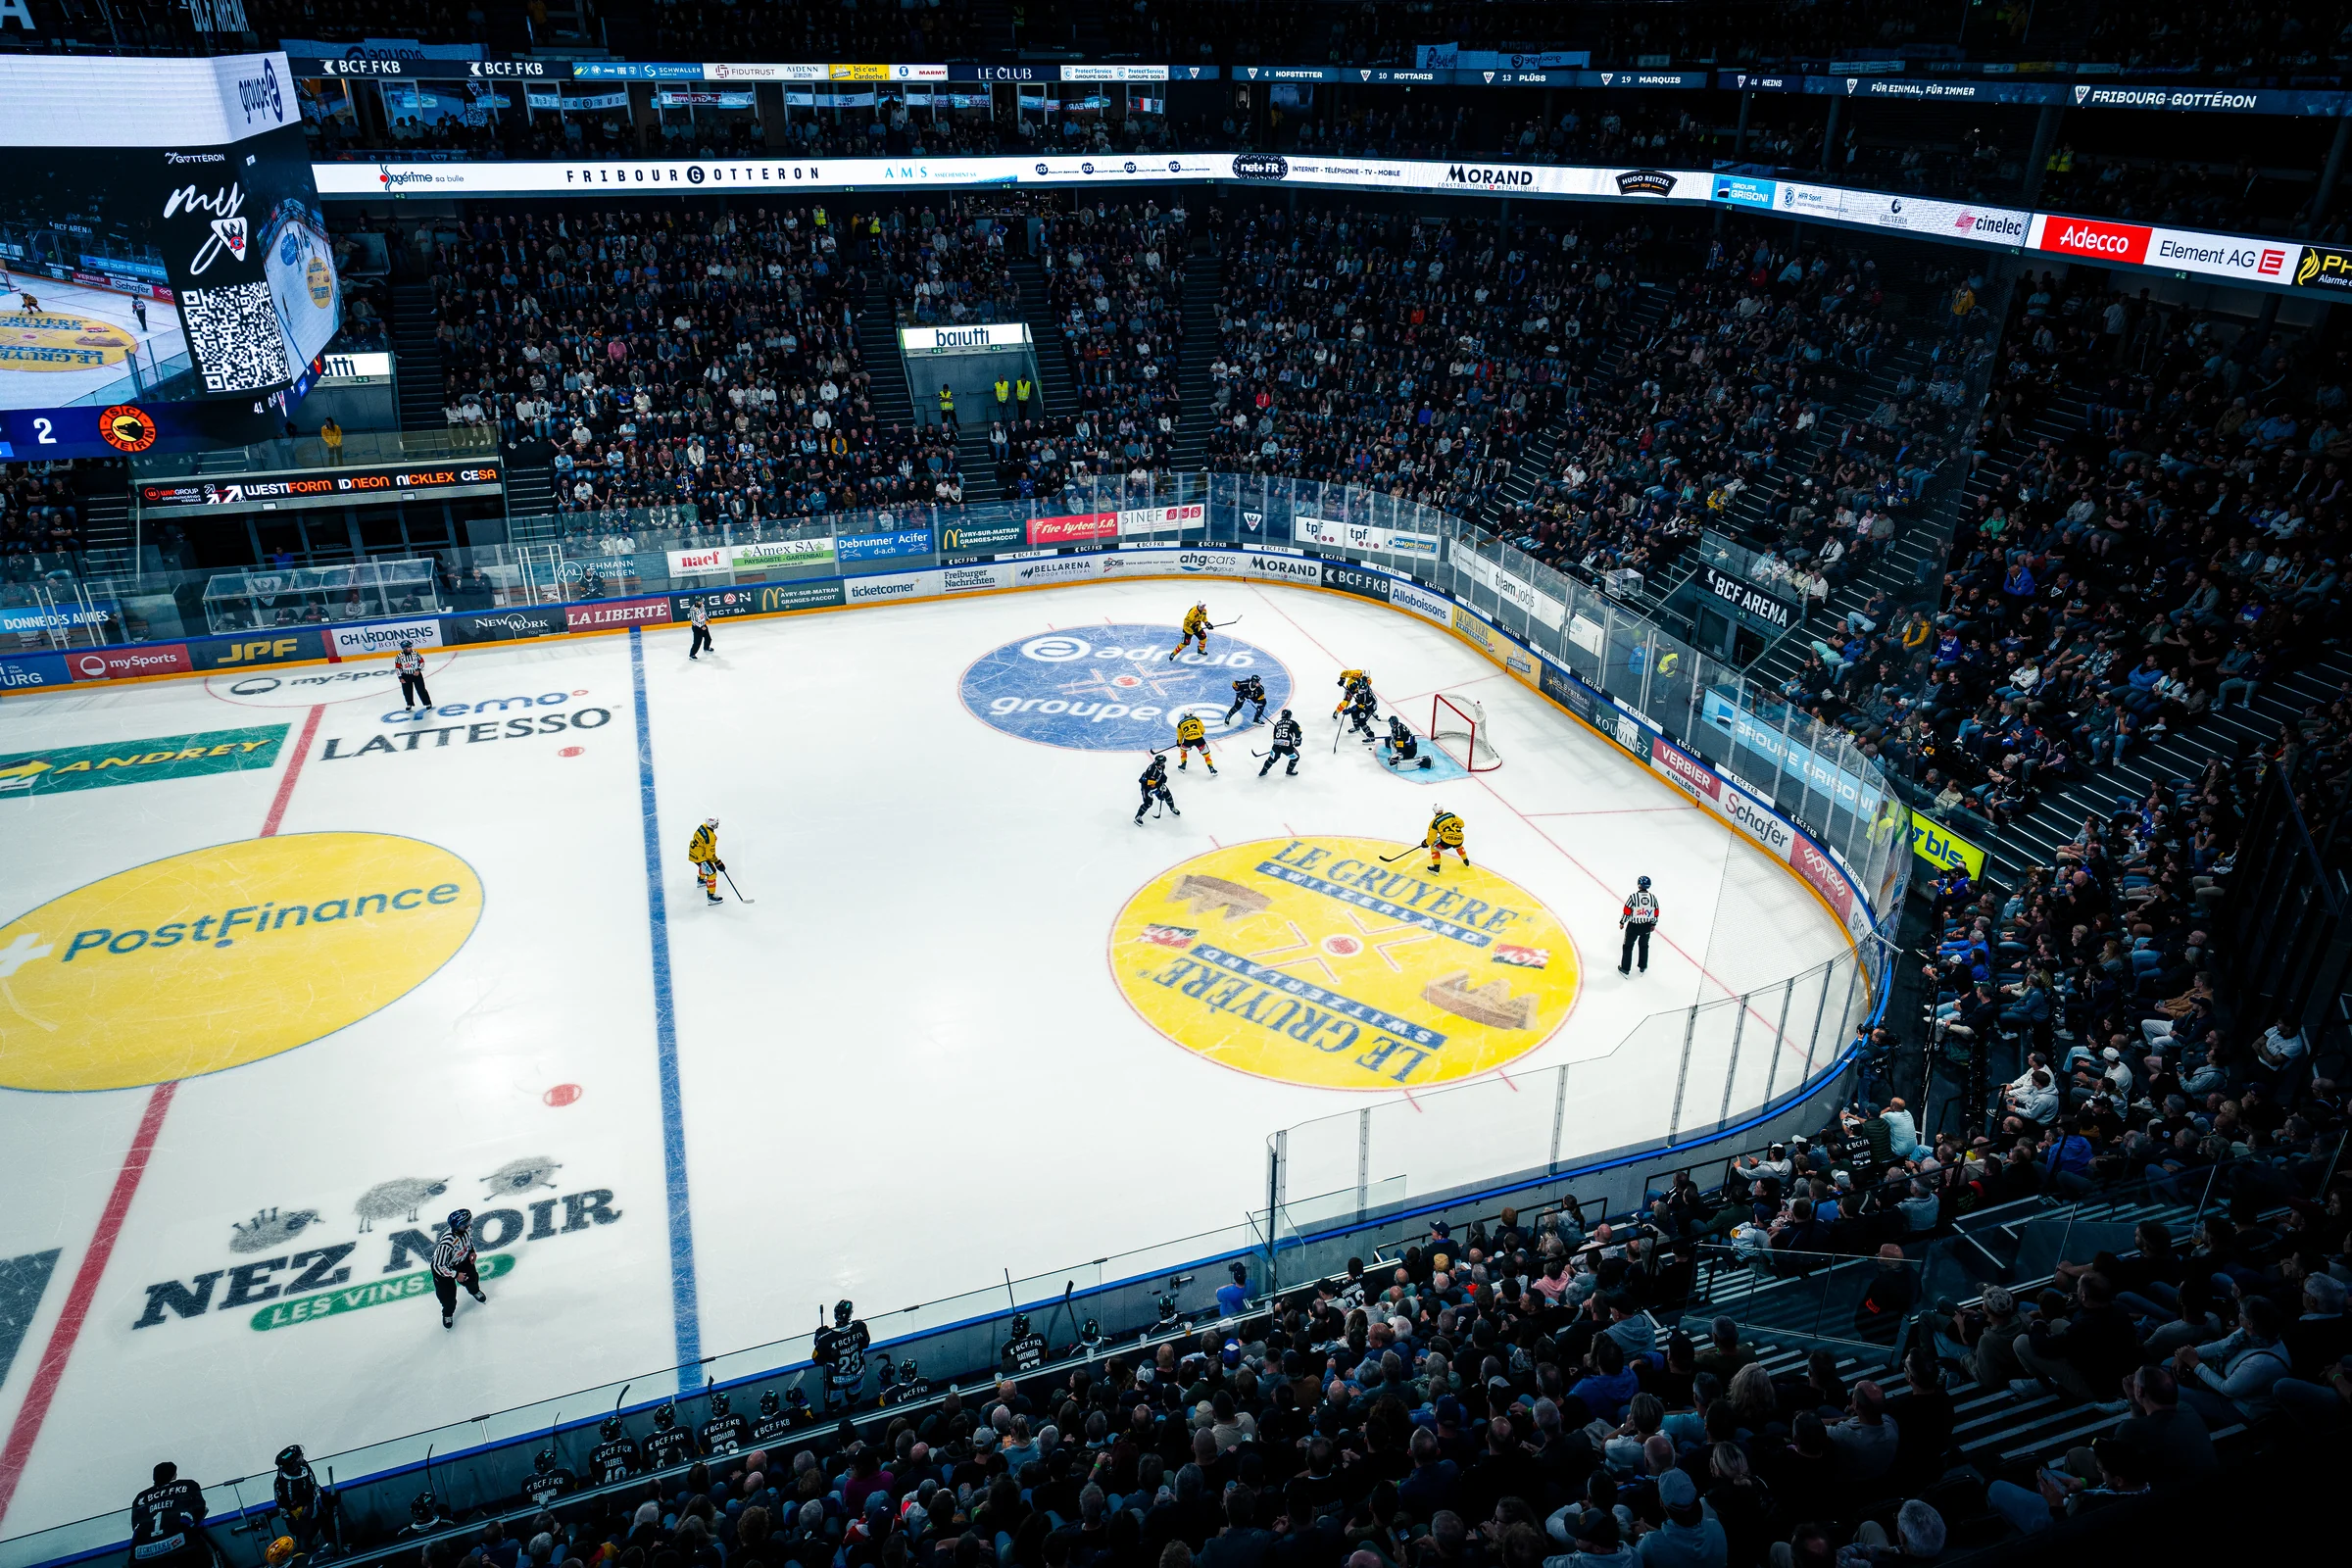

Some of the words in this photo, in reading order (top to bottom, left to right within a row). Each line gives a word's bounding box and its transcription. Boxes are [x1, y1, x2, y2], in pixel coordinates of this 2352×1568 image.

[977, 68, 994, 80] LE
[997, 67, 1033, 80] CLUB
[1378, 72, 1388, 80] 10
[1394, 73, 1434, 81] ROTTARIS
[1502, 74, 1512, 82] 13
[1518, 73, 1546, 82] PLÜSS
[1621, 75, 1632, 84] 19
[1638, 75, 1682, 85] MARQUIS
[1871, 82, 1887, 93] FÜR
[1925, 84, 1943, 95] FÜR
[1943, 86, 1976, 97] IMMER
[239, 77, 270, 124] groupe
[2090, 89, 2257, 109] FRIBOURG-GOTTÉRON
[1265, 162, 1280, 173] FR
[1292, 165, 1320, 173] INTERNET
[1446, 164, 1534, 185] MORAND
[447, 172, 465, 182] bulle
[1621, 174, 1644, 185] HUGO
[1644, 174, 1671, 187] REITZEL
[1732, 182, 1757, 192] GROUPE
[1730, 190, 1769, 203] GRISONI
[69, 224, 93, 234] ARENA
[1976, 215, 2022, 236] cinelec
[2059, 224, 2130, 254] Adecco
[2159, 239, 2225, 265] Element
[2226, 251, 2257, 269] AG
[77, 273, 106, 283] VERBIER
[2318, 274, 2347, 286] Alarme
[115, 279, 151, 295] Schafer
[32, 417, 58, 445] 2
[337, 476, 390, 490] IDNEON
[395, 471, 456, 487] NICKLEX
[460, 468, 498, 482] CESA
[244, 480, 333, 496] WESTIFORM
[959, 527, 1020, 538] AVRY-SUR-MATRAN
[959, 535, 1018, 545] GRANGES-PACCOT
[1350, 527, 1368, 542] tpf
[753, 542, 791, 558] Amex
[795, 540, 816, 554] SA
[838, 537, 894, 551] Debrunner
[898, 532, 928, 545] Acifer
[681, 551, 720, 568] naef
[744, 556, 783, 565] PAYSAGISTE
[786, 552, 824, 563] GARTENBAU
[1034, 561, 1091, 573] BELLARENA
[1179, 553, 1237, 566] ahgcars
[1249, 555, 1317, 577] MORAND
[944, 568, 988, 581] Freiburger
[944, 576, 996, 588] Nachrichten
[780, 587, 840, 598] AVRY-SUR-MATRAN
[851, 582, 915, 598] ticketcorner
[780, 595, 836, 605] GRANGES-PACCOT
[1392, 587, 1447, 620] Alloboissons
[1713, 575, 1743, 604] BCF
[1740, 590, 1788, 628] ARENA
[4, 615, 48, 630] DONNE
[567, 613, 592, 626] LA
[594, 602, 668, 624] LIBERTÉ
[340, 626, 434, 650] CHARDONNENS
[218, 637, 298, 667] JPF
[109, 653, 178, 672] mySports
[989, 696, 1163, 727] groupe
[318, 707, 614, 761] LATTESSO
[1594, 713, 1649, 759] ROUVINEZ
[59, 737, 272, 778] ANDREY
[1661, 744, 1712, 791] VERBIER
[1736, 719, 1799, 768] GROUPE
[1802, 759, 1876, 814] GRISONI
[1671, 772, 1696, 795] VALLÉES
[1725, 792, 1788, 848] Schafer
[1270, 840, 1333, 873] LE
[1326, 859, 1522, 942] GRUYÈRE
[1263, 863, 1483, 948] SWITZERLAND
[62, 884, 461, 962] PostFinance
[1197, 944, 1441, 1050] SWITZERLAND
[1154, 959, 1364, 1057] GRUYÈRE
[1356, 1036, 1433, 1083] LE
[132, 1241, 359, 1331] NEZ
[382, 1187, 623, 1276] NOIR
[272, 1302, 335, 1333] LES
[347, 1273, 426, 1316] VINS
[149, 1499, 175, 1514] GALLEY
[150, 1510, 165, 1538] 1
